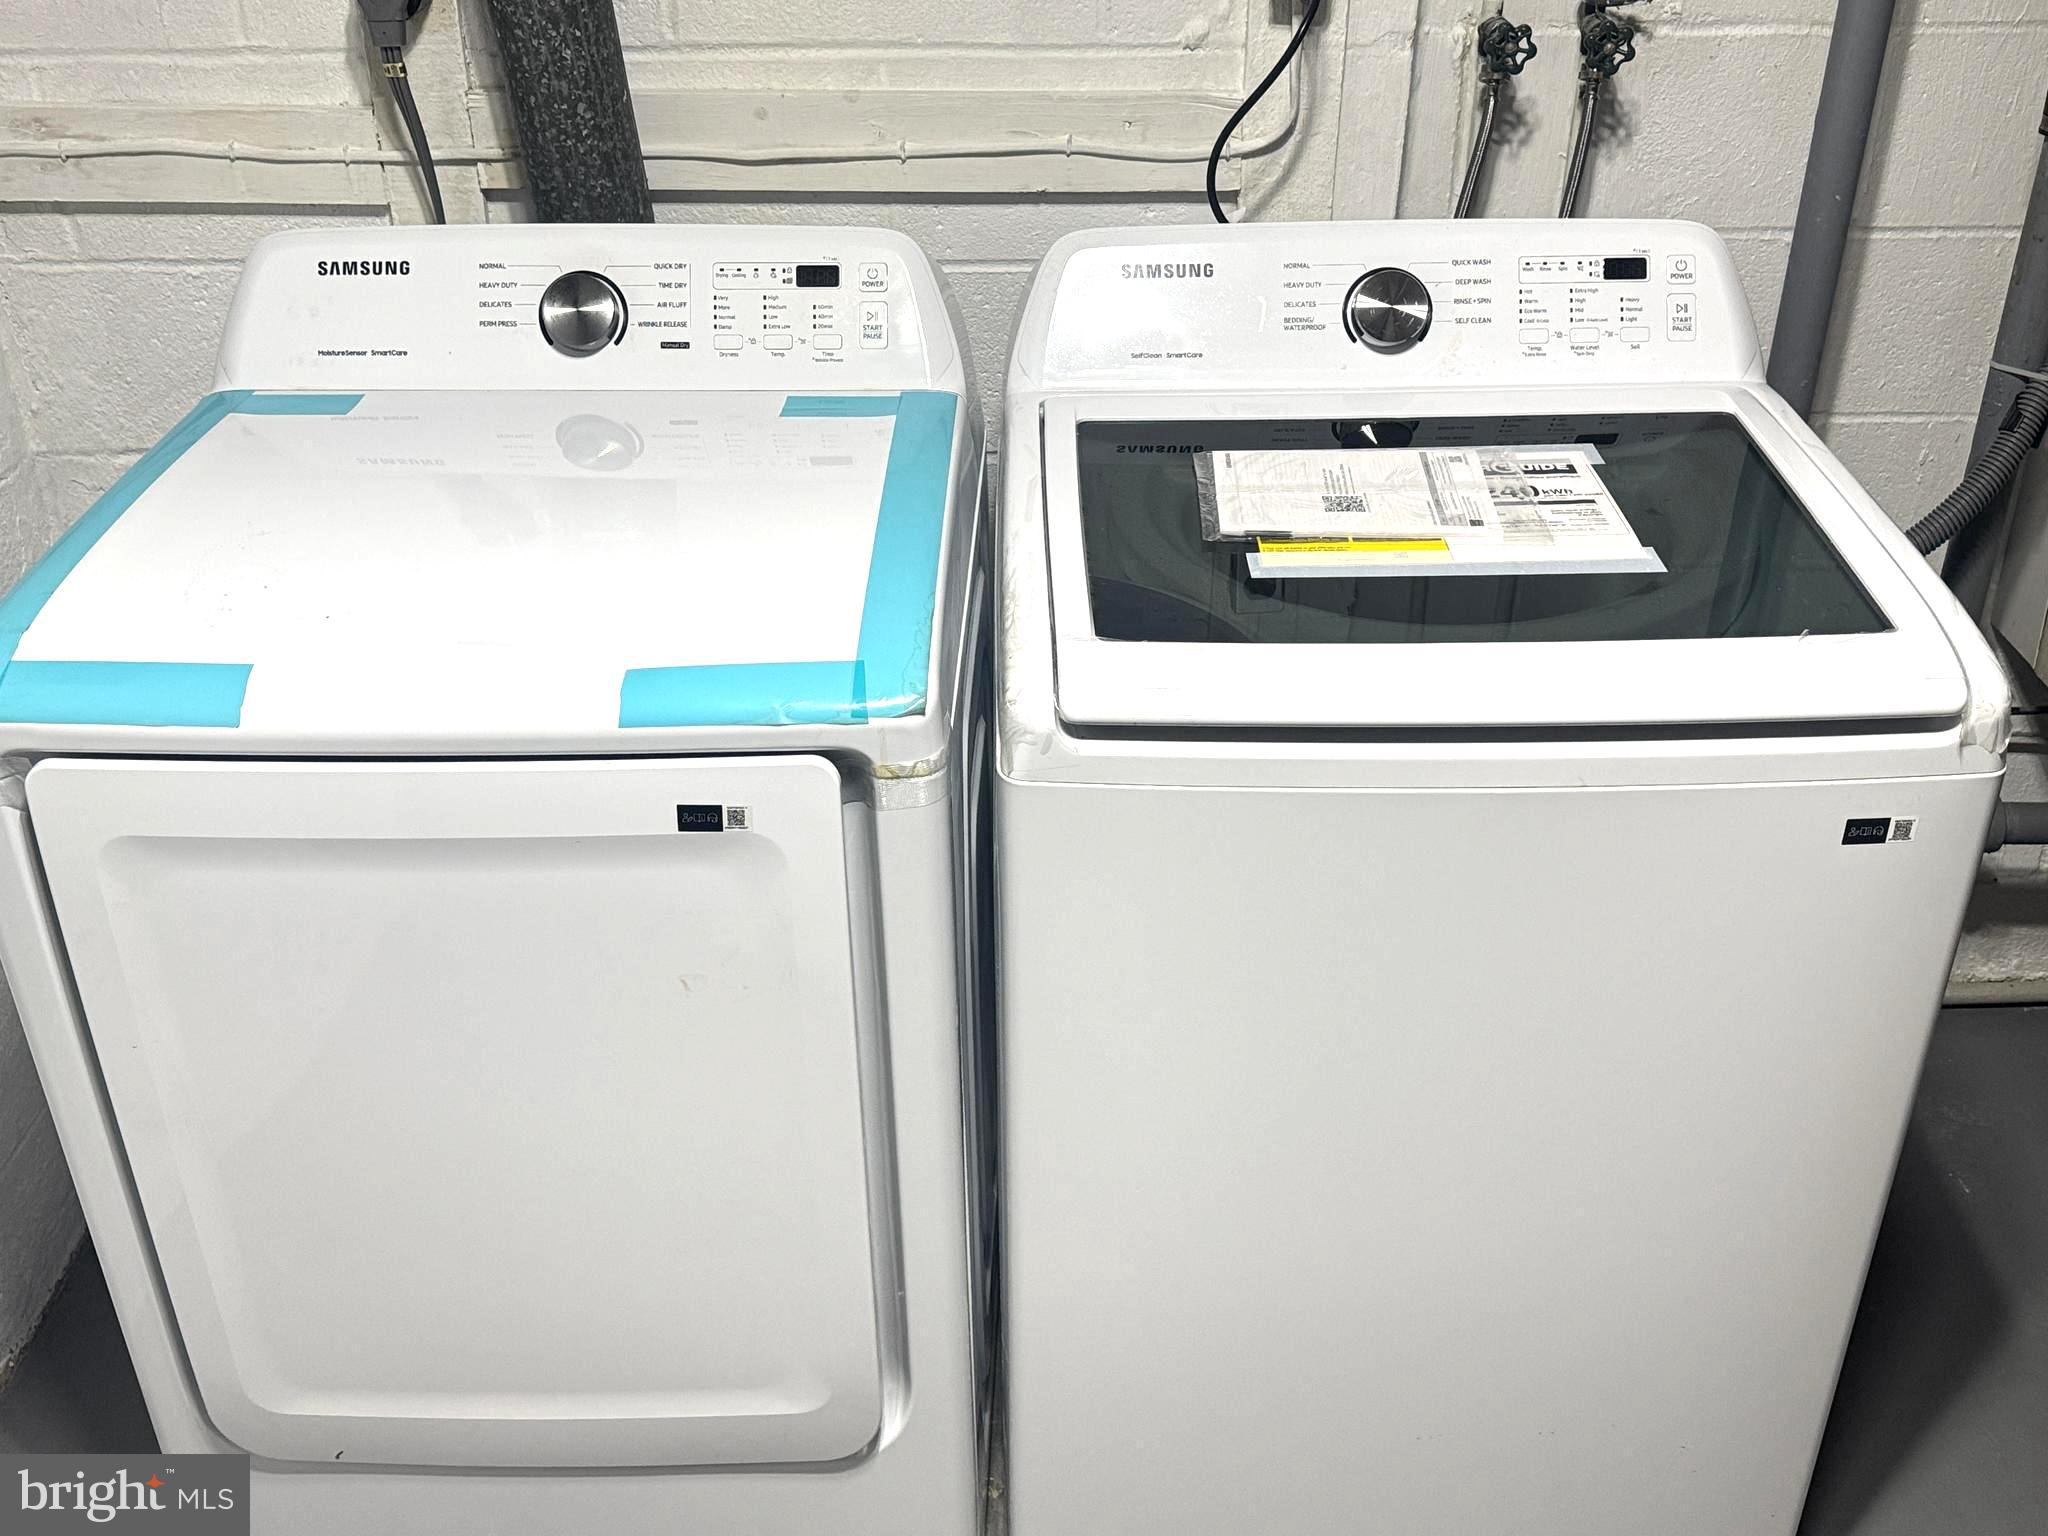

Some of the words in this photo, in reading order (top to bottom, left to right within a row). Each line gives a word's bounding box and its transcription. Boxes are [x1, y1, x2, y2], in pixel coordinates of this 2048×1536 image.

[1283, 262, 1311, 270] NORMAL
[1451, 258, 1471, 267] QUICK
[1472, 258, 1492, 266] WASH
[317, 260, 411, 276] SAMSUNG
[1121, 262, 1214, 279] SAMSUNG
[1670, 272, 1693, 280] POWER
[479, 282, 500, 290] HEAVY
[861, 280, 884, 288] POWER
[1283, 281, 1305, 289] HEAVY
[1305, 281, 1322, 289] DUTY
[1455, 278, 1472, 286] DEEP
[1472, 278, 1492, 286] WASH
[479, 301, 513, 309] DELICATES
[656, 301, 670, 309] AIR
[670, 301, 688, 309] FLUFF
[1283, 300, 1317, 308] DELICATES
[479, 320, 498, 328] PERM
[498, 320, 518, 328] PRESS
[637, 320, 663, 328] WRINKLE
[662, 320, 688, 328] RELEASE
[1283, 316, 1315, 325] BEDDING/
[1454, 317, 1470, 325] SELF
[1470, 316, 1492, 325] CLEAN
[1283, 324, 1327, 332] WATERPROOF
[317, 349, 368, 358] MoistureSensor
[370, 349, 408, 357] SmartCare
[1130, 351, 1163, 359] SelfClean
[1165, 351, 1204, 359] SmartCare
[1541, 488, 1574, 496] kWh
